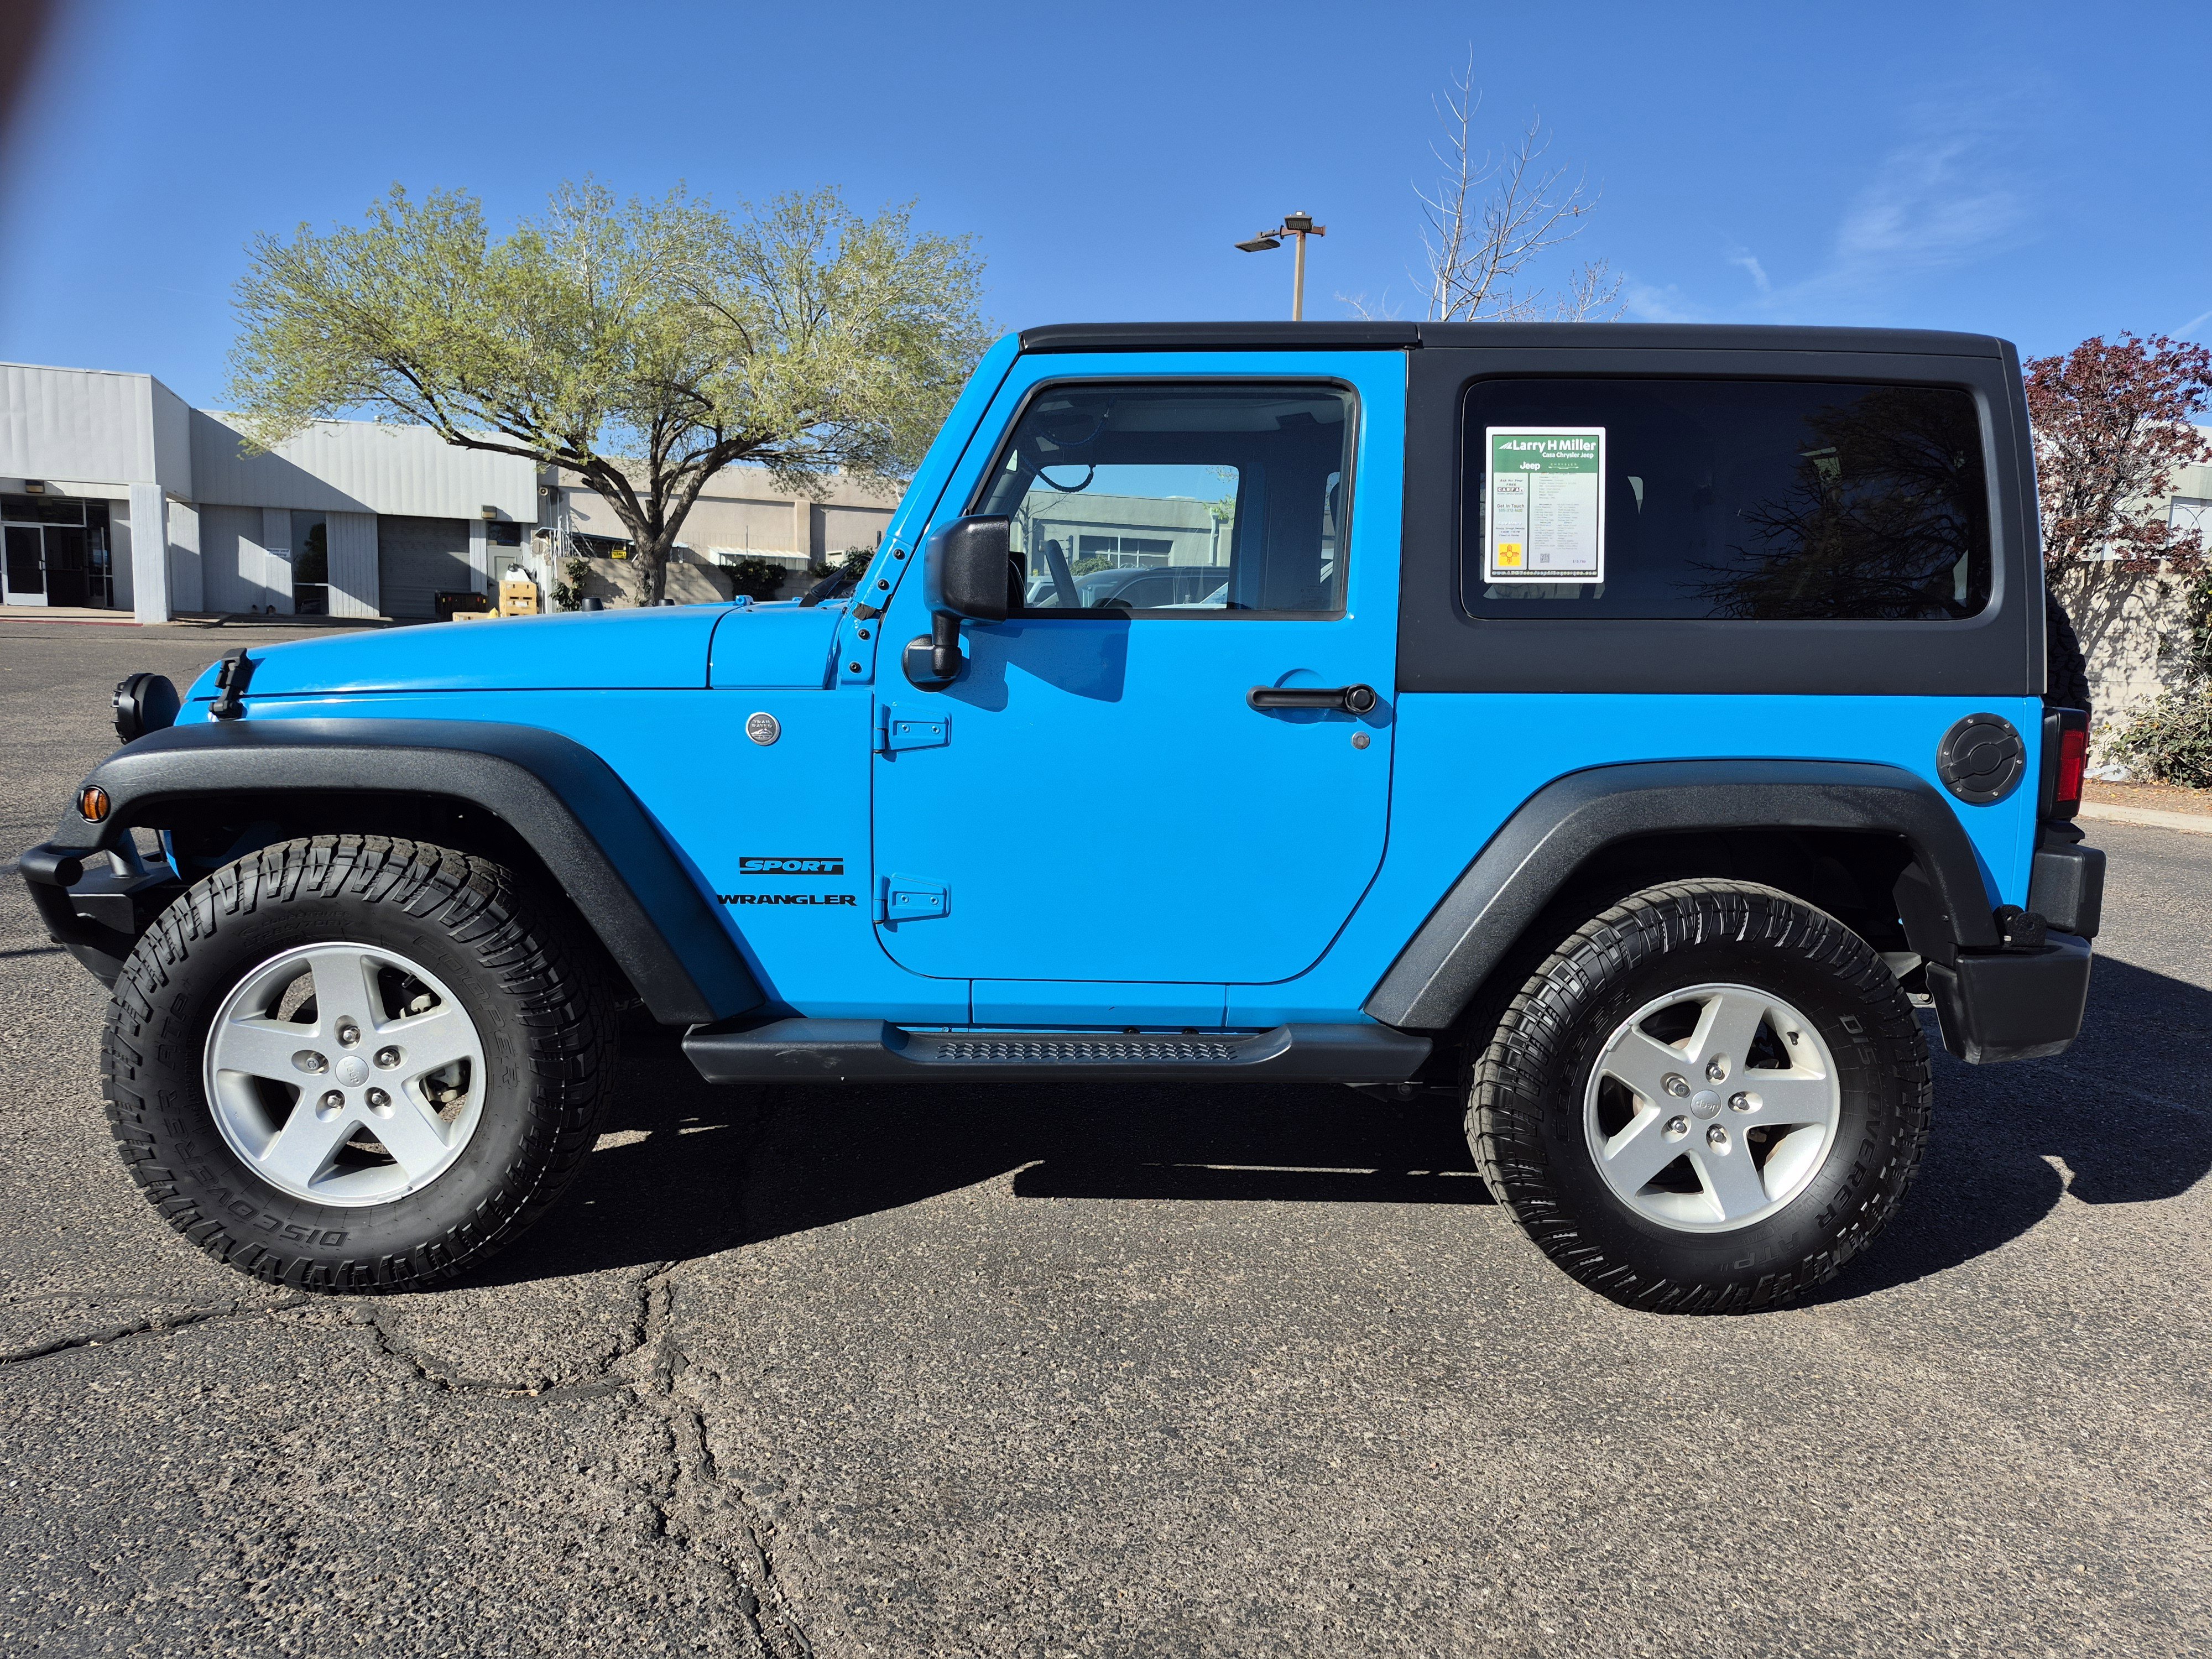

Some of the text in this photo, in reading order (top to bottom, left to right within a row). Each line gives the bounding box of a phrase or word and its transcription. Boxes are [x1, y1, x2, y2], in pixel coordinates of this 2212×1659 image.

[1513, 439, 1596, 453] Larry H Miller
[1519, 461, 1541, 471] Jeep
[740, 859, 843, 873] SPORT
[717, 894, 857, 906] WRANGLER
[413, 933, 518, 1088] COOPER
[344, 1061, 360, 1084] Jeep
[1554, 987, 1632, 1142] COOPER
[1695, 1099, 1719, 1112] Jeep
[1814, 1013, 1882, 1229] DISCOVERER
[158, 1088, 349, 1248] DISCOVERER
